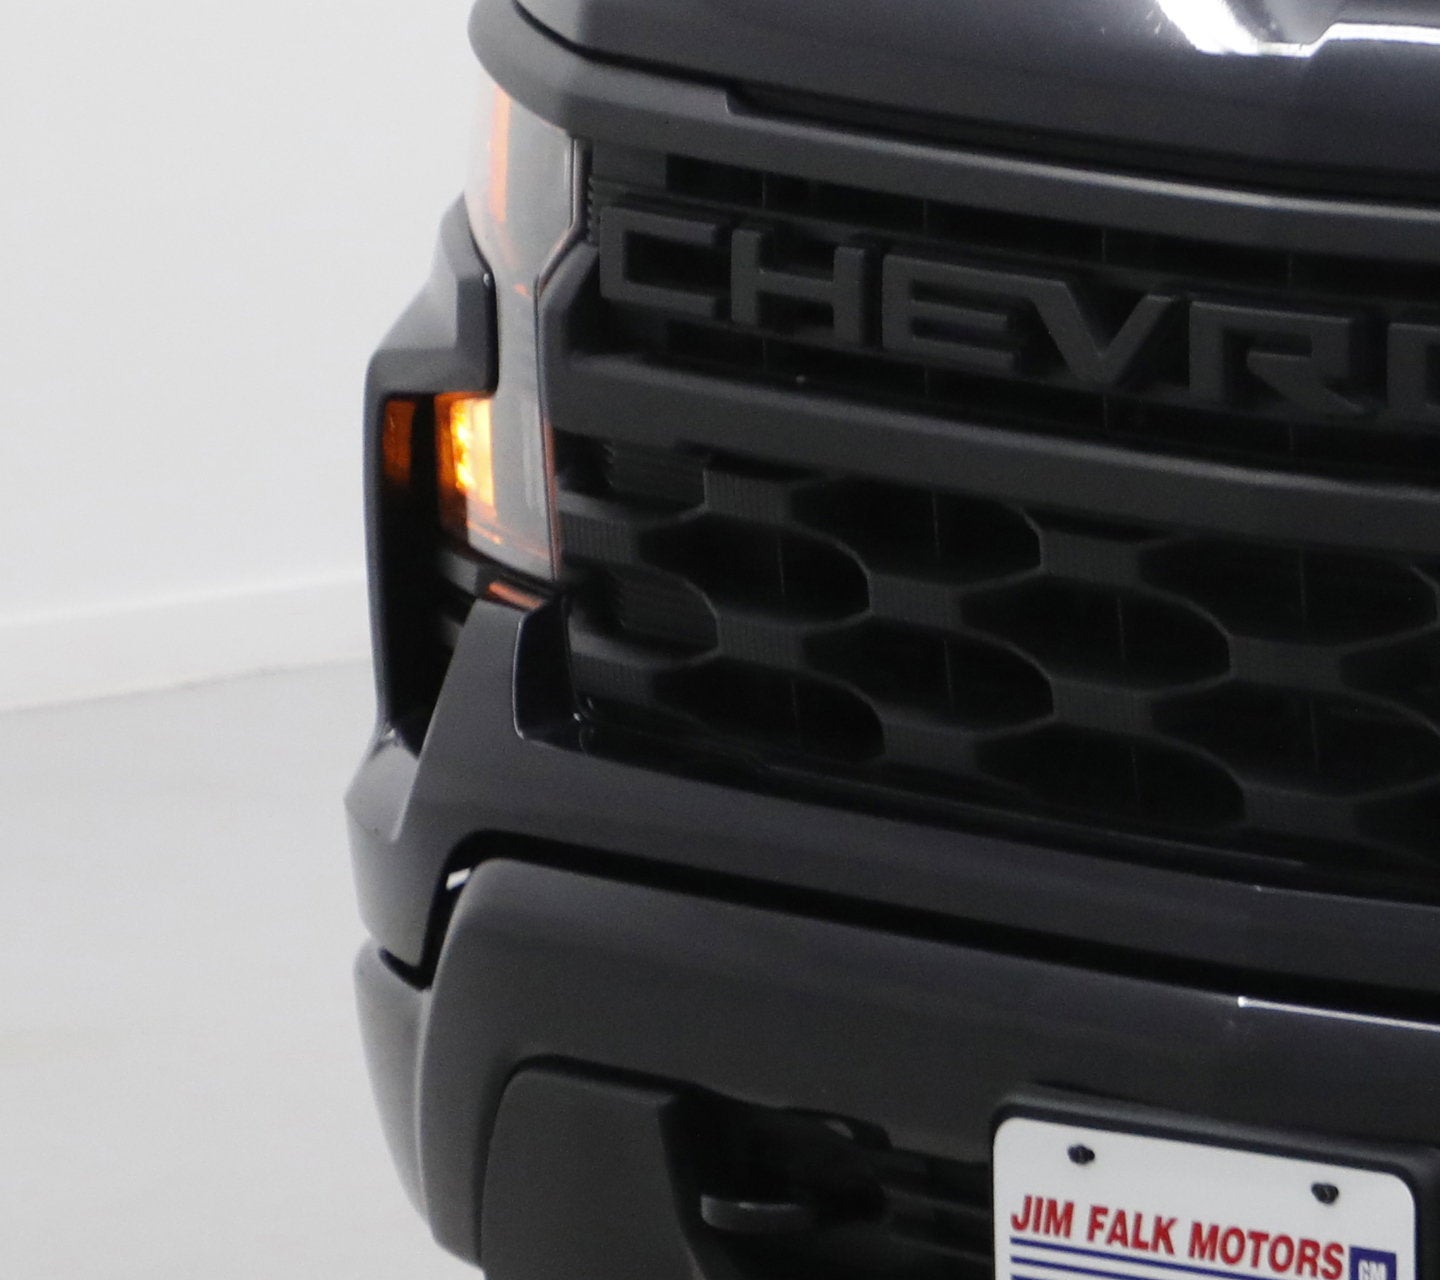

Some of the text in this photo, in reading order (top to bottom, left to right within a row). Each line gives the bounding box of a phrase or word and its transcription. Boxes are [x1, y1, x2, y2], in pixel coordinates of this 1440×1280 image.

[1011, 1195, 1345, 1280] JIM FALK MOTORS
